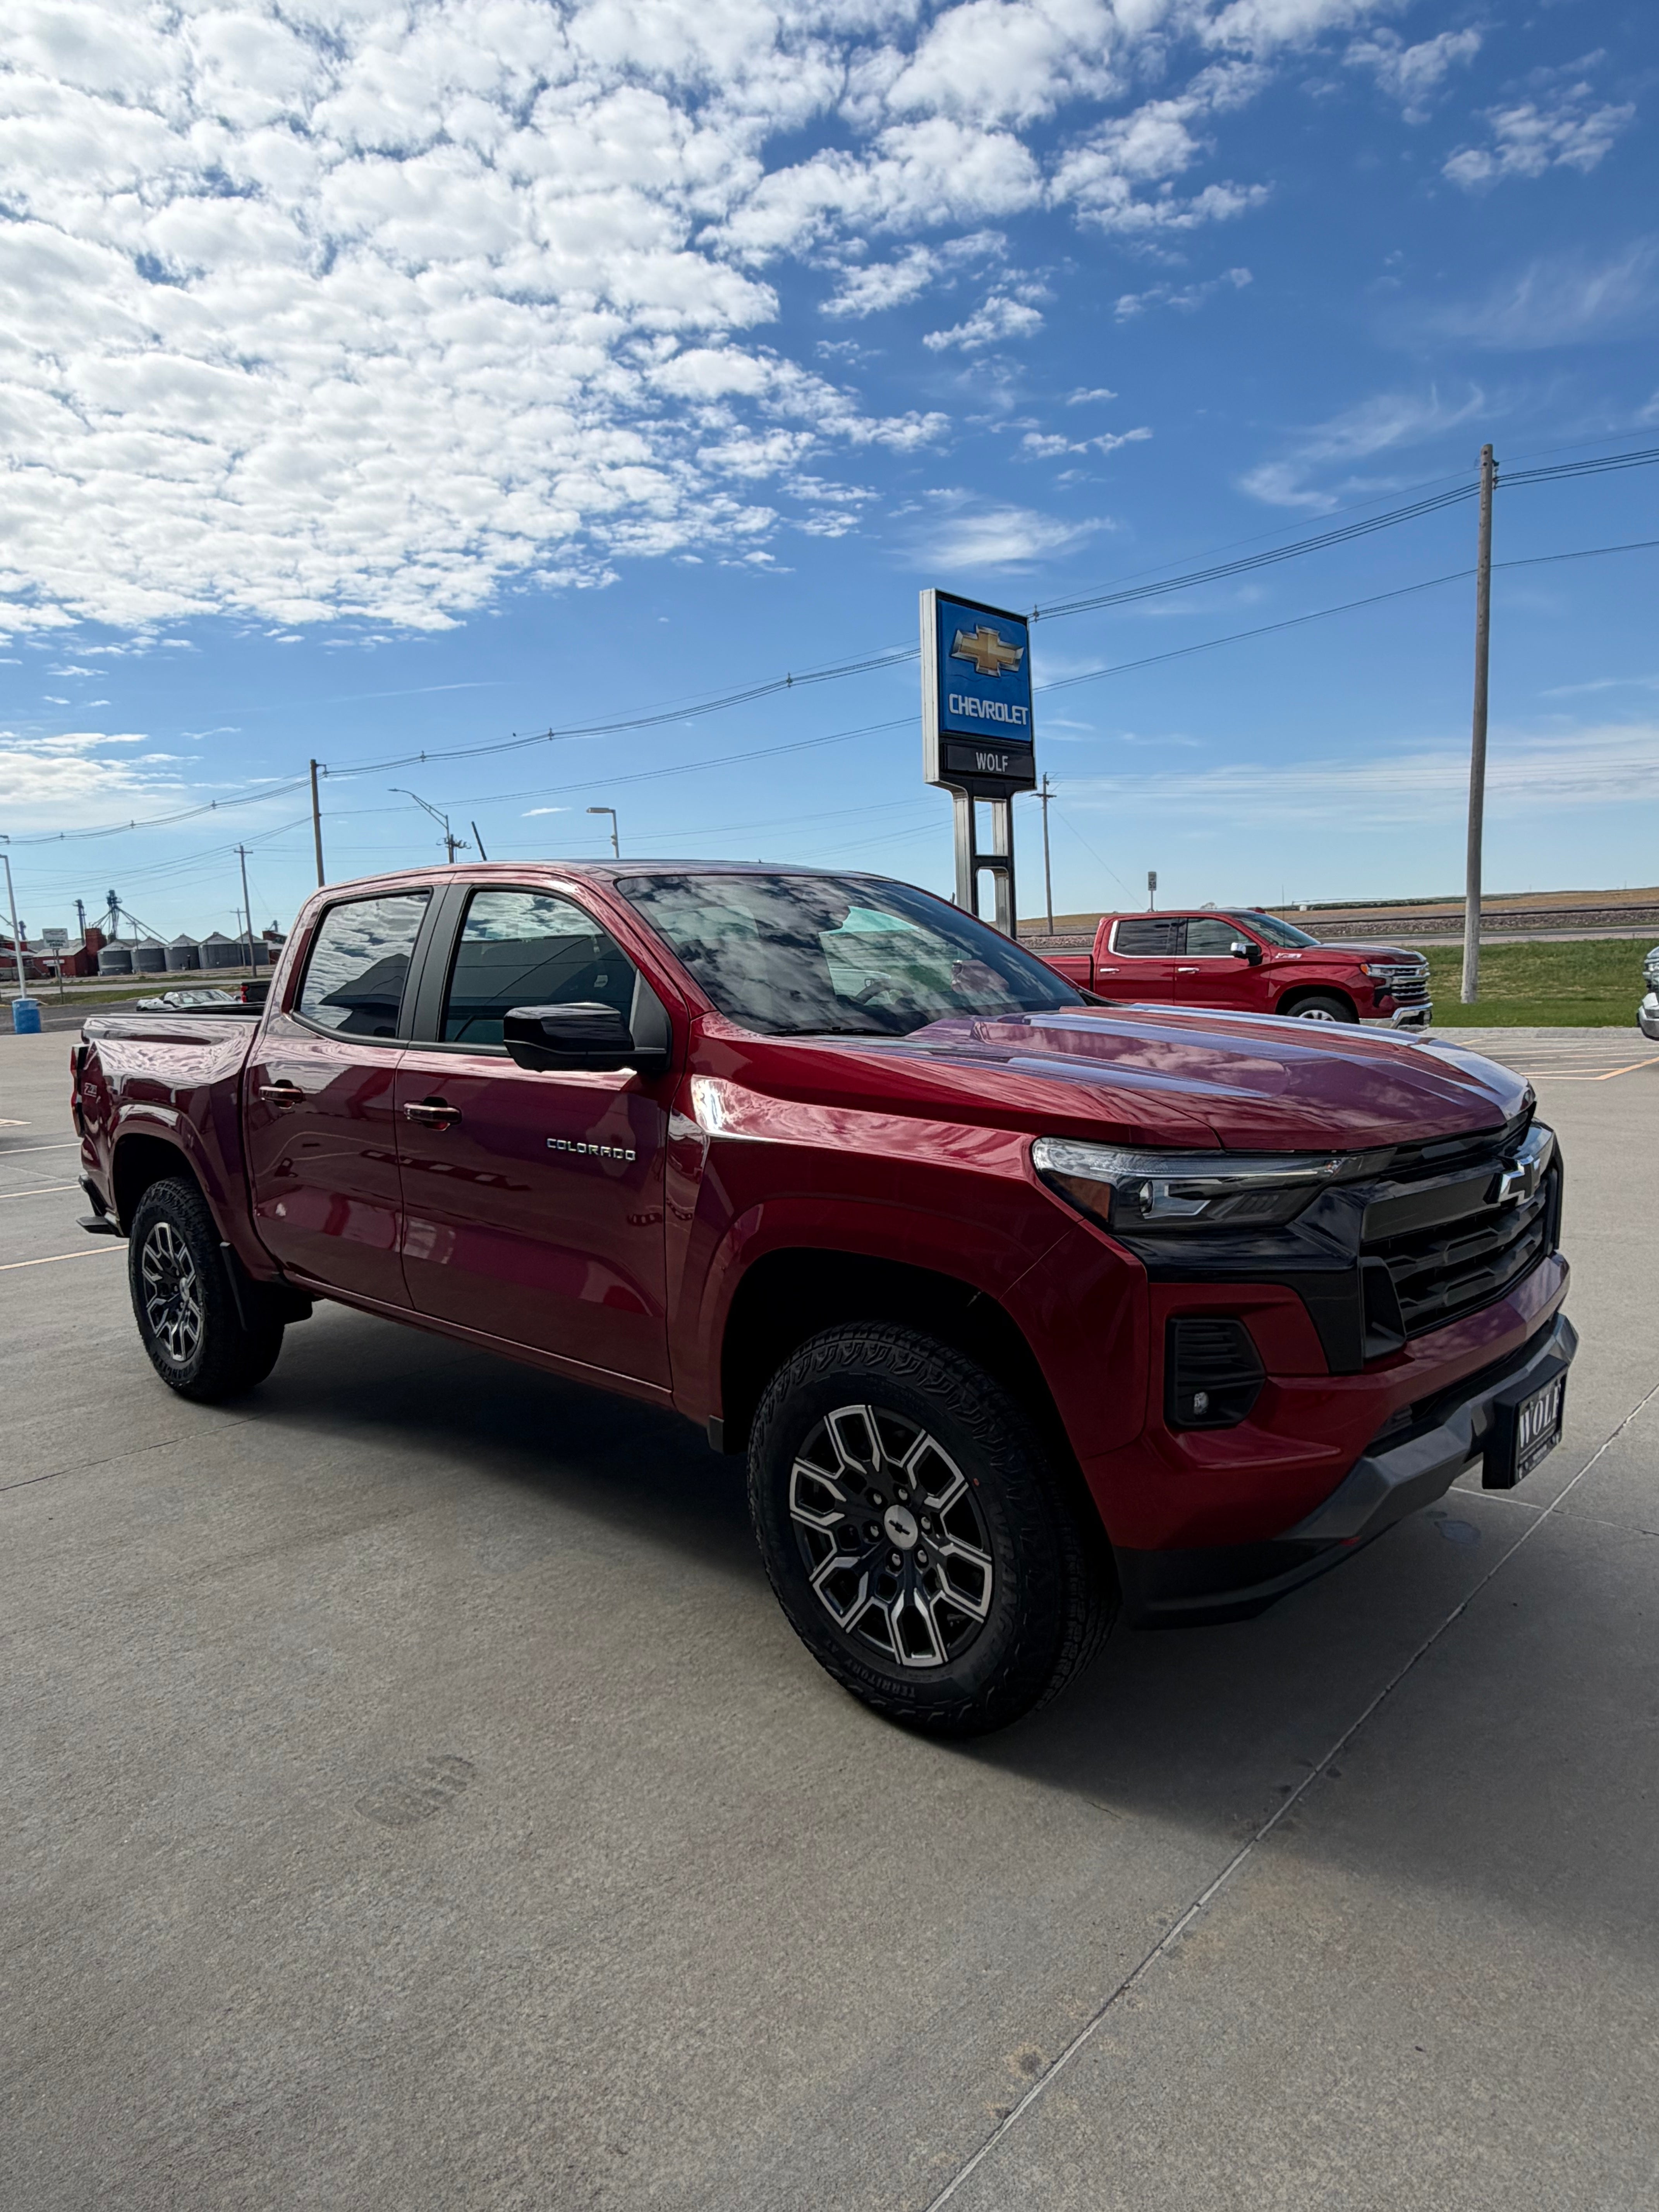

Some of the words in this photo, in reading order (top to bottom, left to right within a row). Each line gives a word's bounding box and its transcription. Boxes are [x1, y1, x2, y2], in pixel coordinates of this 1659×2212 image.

[949, 693, 1029, 725] CHEVROLET
[976, 752, 1008, 772] WOLF
[547, 1138, 635, 1161] COLORADO
[1519, 1383, 1561, 1448] WOLF
